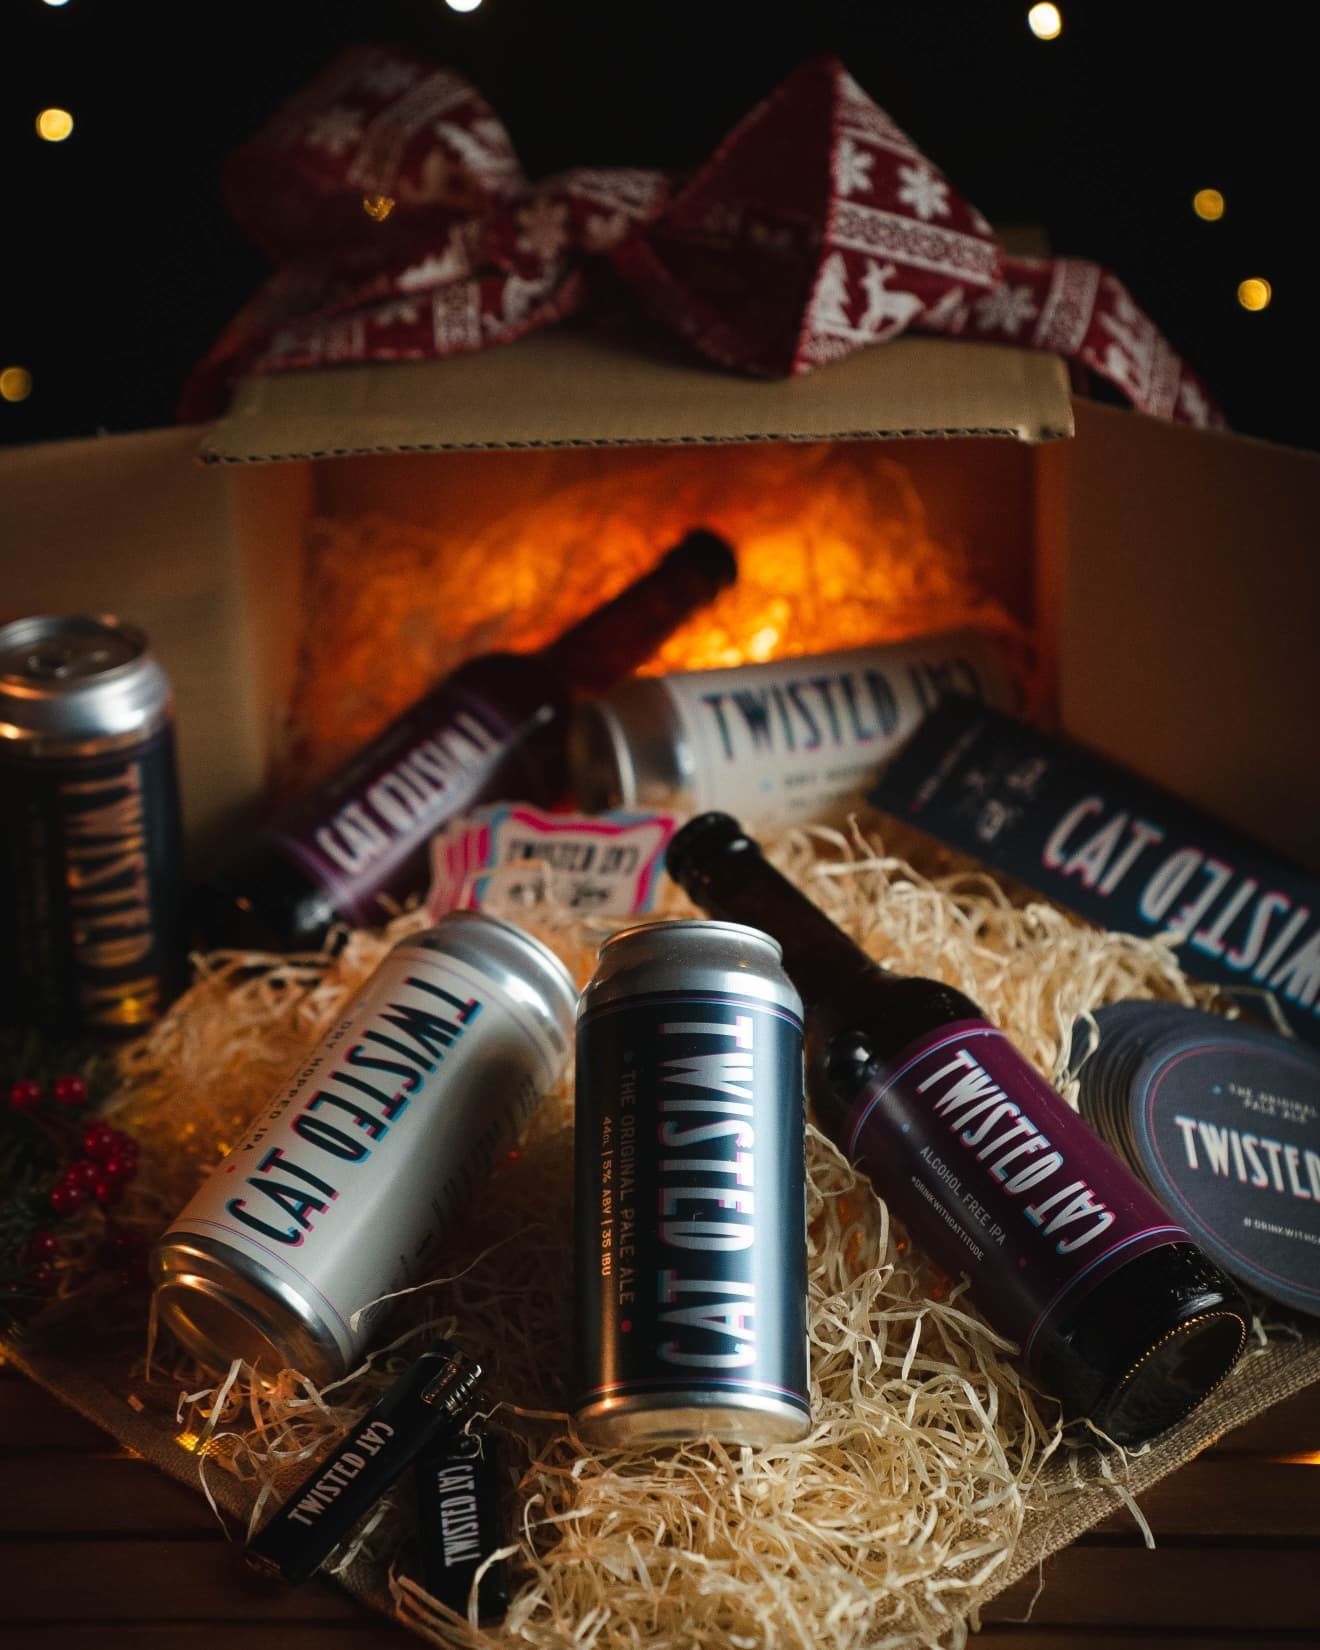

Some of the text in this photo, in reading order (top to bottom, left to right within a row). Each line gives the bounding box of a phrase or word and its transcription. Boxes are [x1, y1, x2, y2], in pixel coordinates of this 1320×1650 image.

[702, 669, 900, 763] TWISTED
[1041, 796, 1320, 1018] CAT WISTED
[242, 1021, 352, 1152] DRY HOPPED IPA
[290, 976, 483, 1164] TWISTED
[226, 1147, 339, 1248] CAT
[601, 1159, 616, 1185] 5%
[601, 1188, 615, 1215] ABV
[618, 1068, 638, 1306] THE ORIGINAL PALE ALE
[656, 1015, 757, 1369] TWISTED CAT
[914, 1048, 1118, 1256] TWISTED CAT
[919, 1145, 1008, 1247] ALCOHOL FREE IPA
[601, 1228, 614, 1248] 35
[601, 1251, 614, 1277] IBU
[288, 1420, 396, 1527] TWISTED CAT
[437, 1464, 482, 1568] CAT TWISTED
